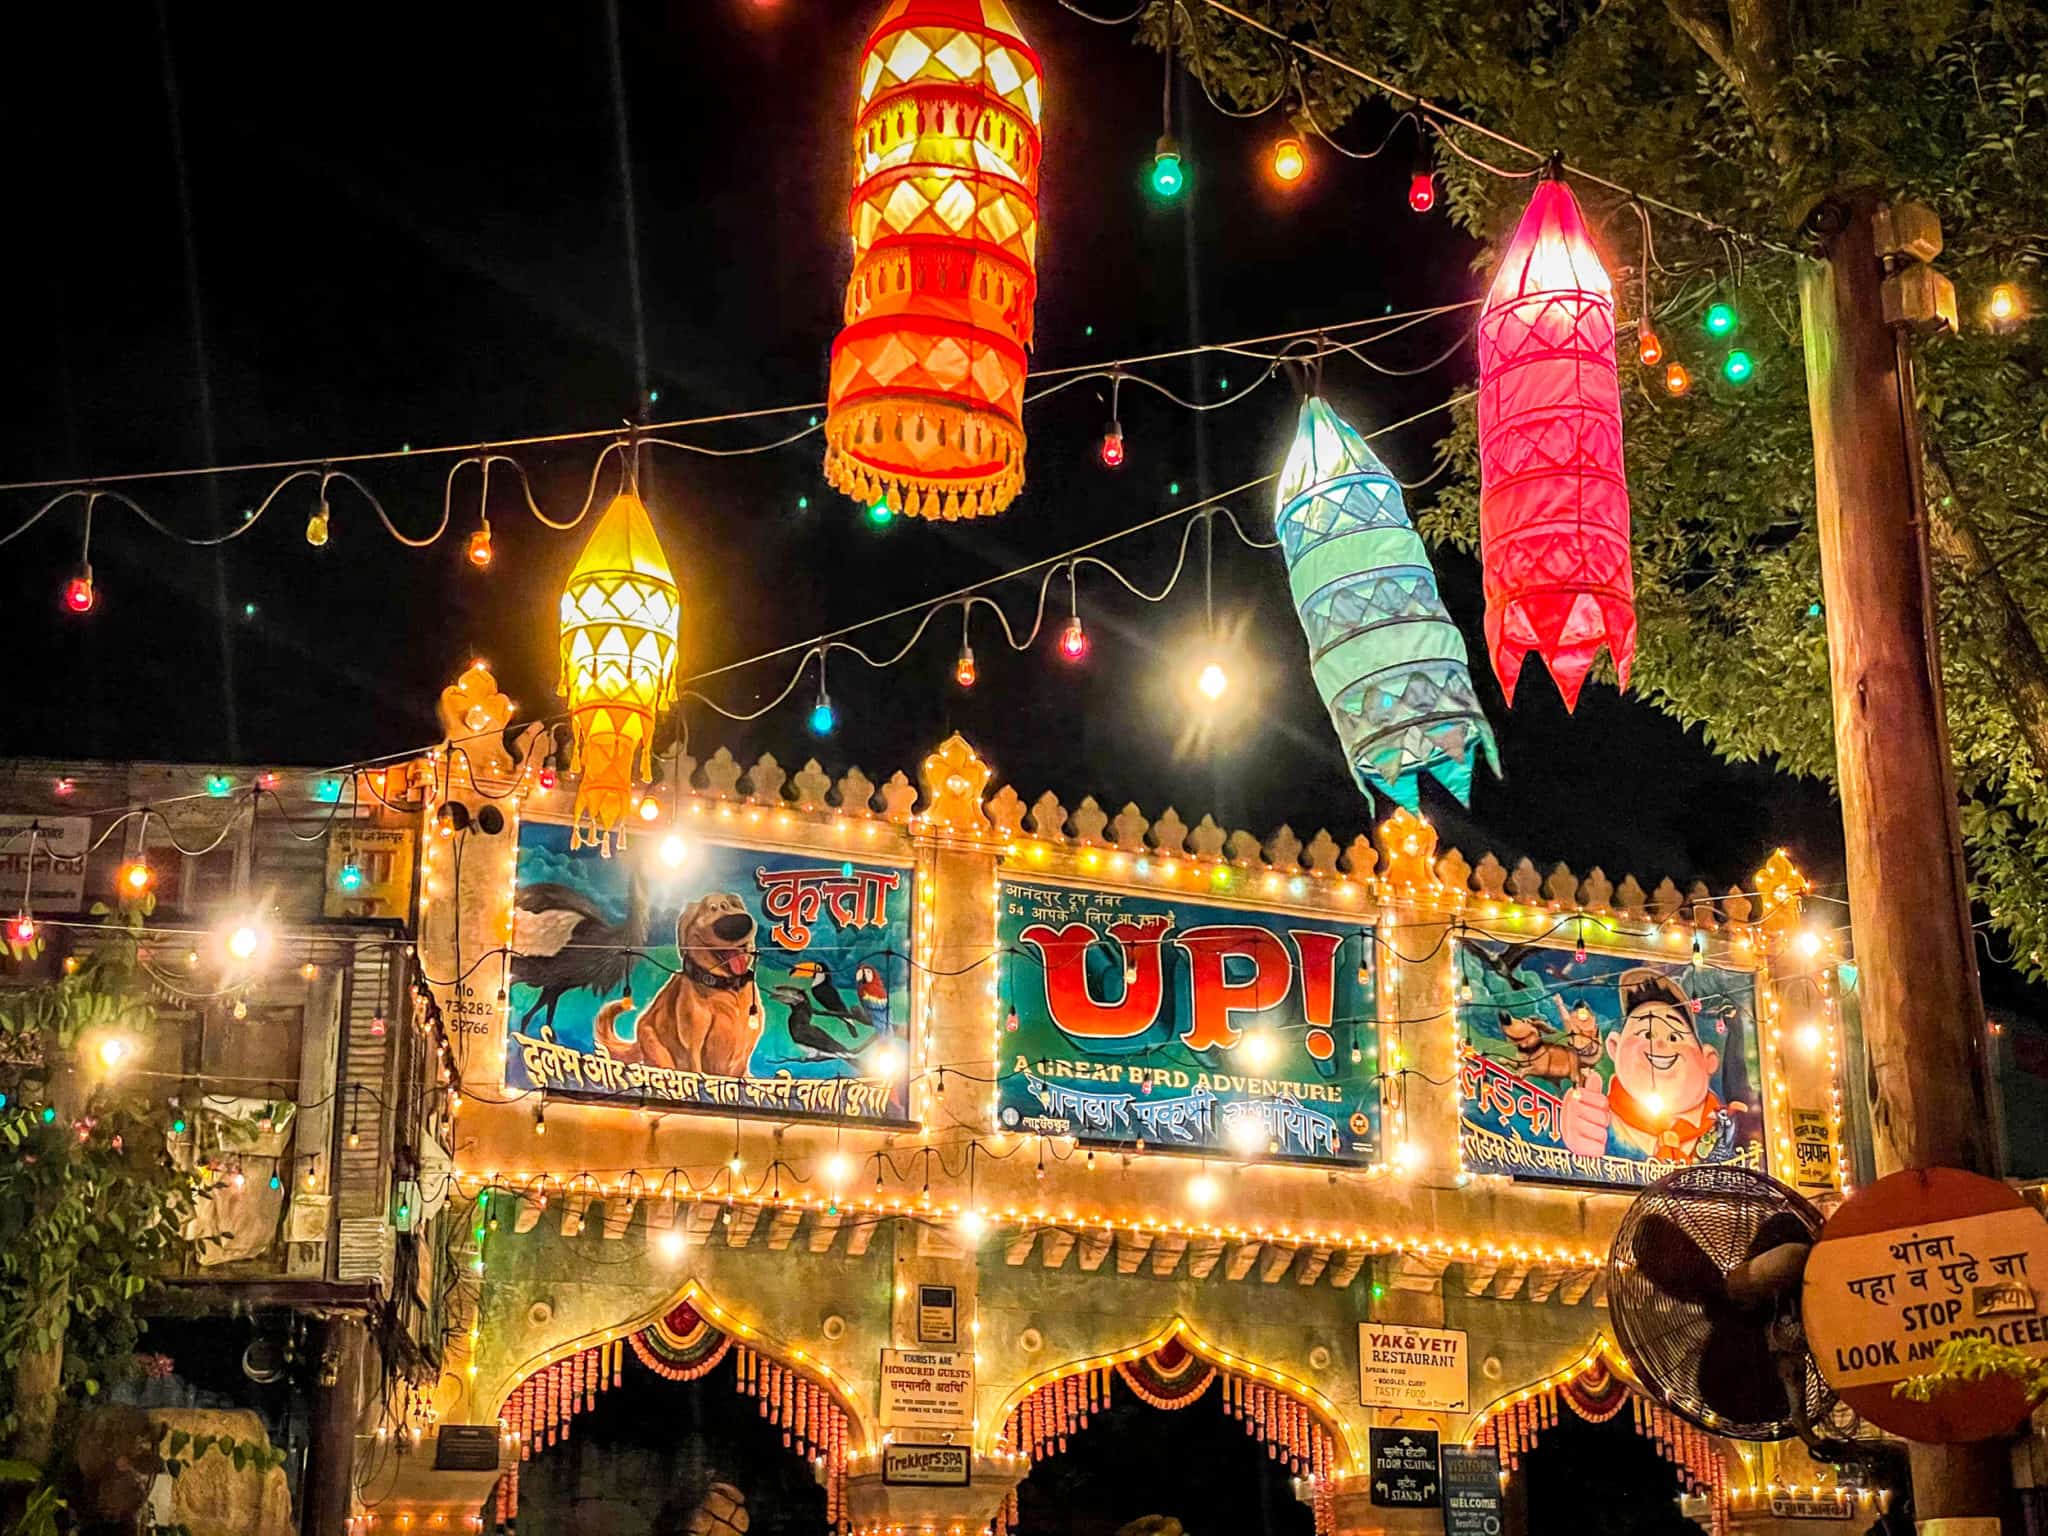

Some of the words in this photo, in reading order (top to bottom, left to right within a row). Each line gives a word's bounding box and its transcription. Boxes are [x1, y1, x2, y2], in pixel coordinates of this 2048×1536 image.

[756, 866, 900, 951] कुत्ता
[1006, 883, 1061, 906] आनंदपुर
[1008, 904, 1024, 916] 54
[1032, 906, 1070, 923] आपके
[1085, 908, 1113, 928] लिए
[1019, 922, 1344, 1061] UP!
[511, 1025, 584, 1088] दुर्लभ
[582, 1040, 628, 1090] और
[1014, 1055, 1032, 1075] A
[1037, 1058, 1123, 1083] GREAT
[1197, 1073, 1342, 1103] ADVENTURE
[1459, 1040, 1562, 1143] लड़का
[1506, 1126, 1537, 1169] और
[1889, 1232, 1956, 1264] थांबा
[1847, 1273, 1896, 1305] पहा
[1907, 1268, 1928, 1291] व
[1938, 1252, 1979, 1294] पुढे
[1989, 1252, 2029, 1278] जा
[1902, 1299, 1962, 1332] STOP
[904, 1354, 937, 1365] TOURISTS
[939, 1356, 953, 1366] ARE
[1373, 1350, 1456, 1368] RESTAURANT
[1419, 1337, 1458, 1354] YETI
[1836, 1340, 1900, 1372] LOOK
[885, 1365, 935, 1377] HONOURED
[937, 1367, 972, 1379] GUESTS
[1377, 1458, 1402, 1469] FLOOR
[1403, 1459, 1437, 1471] SEATING
[1391, 1490, 1423, 1502] STANDS
[1449, 1497, 1498, 1510] WELCOME
